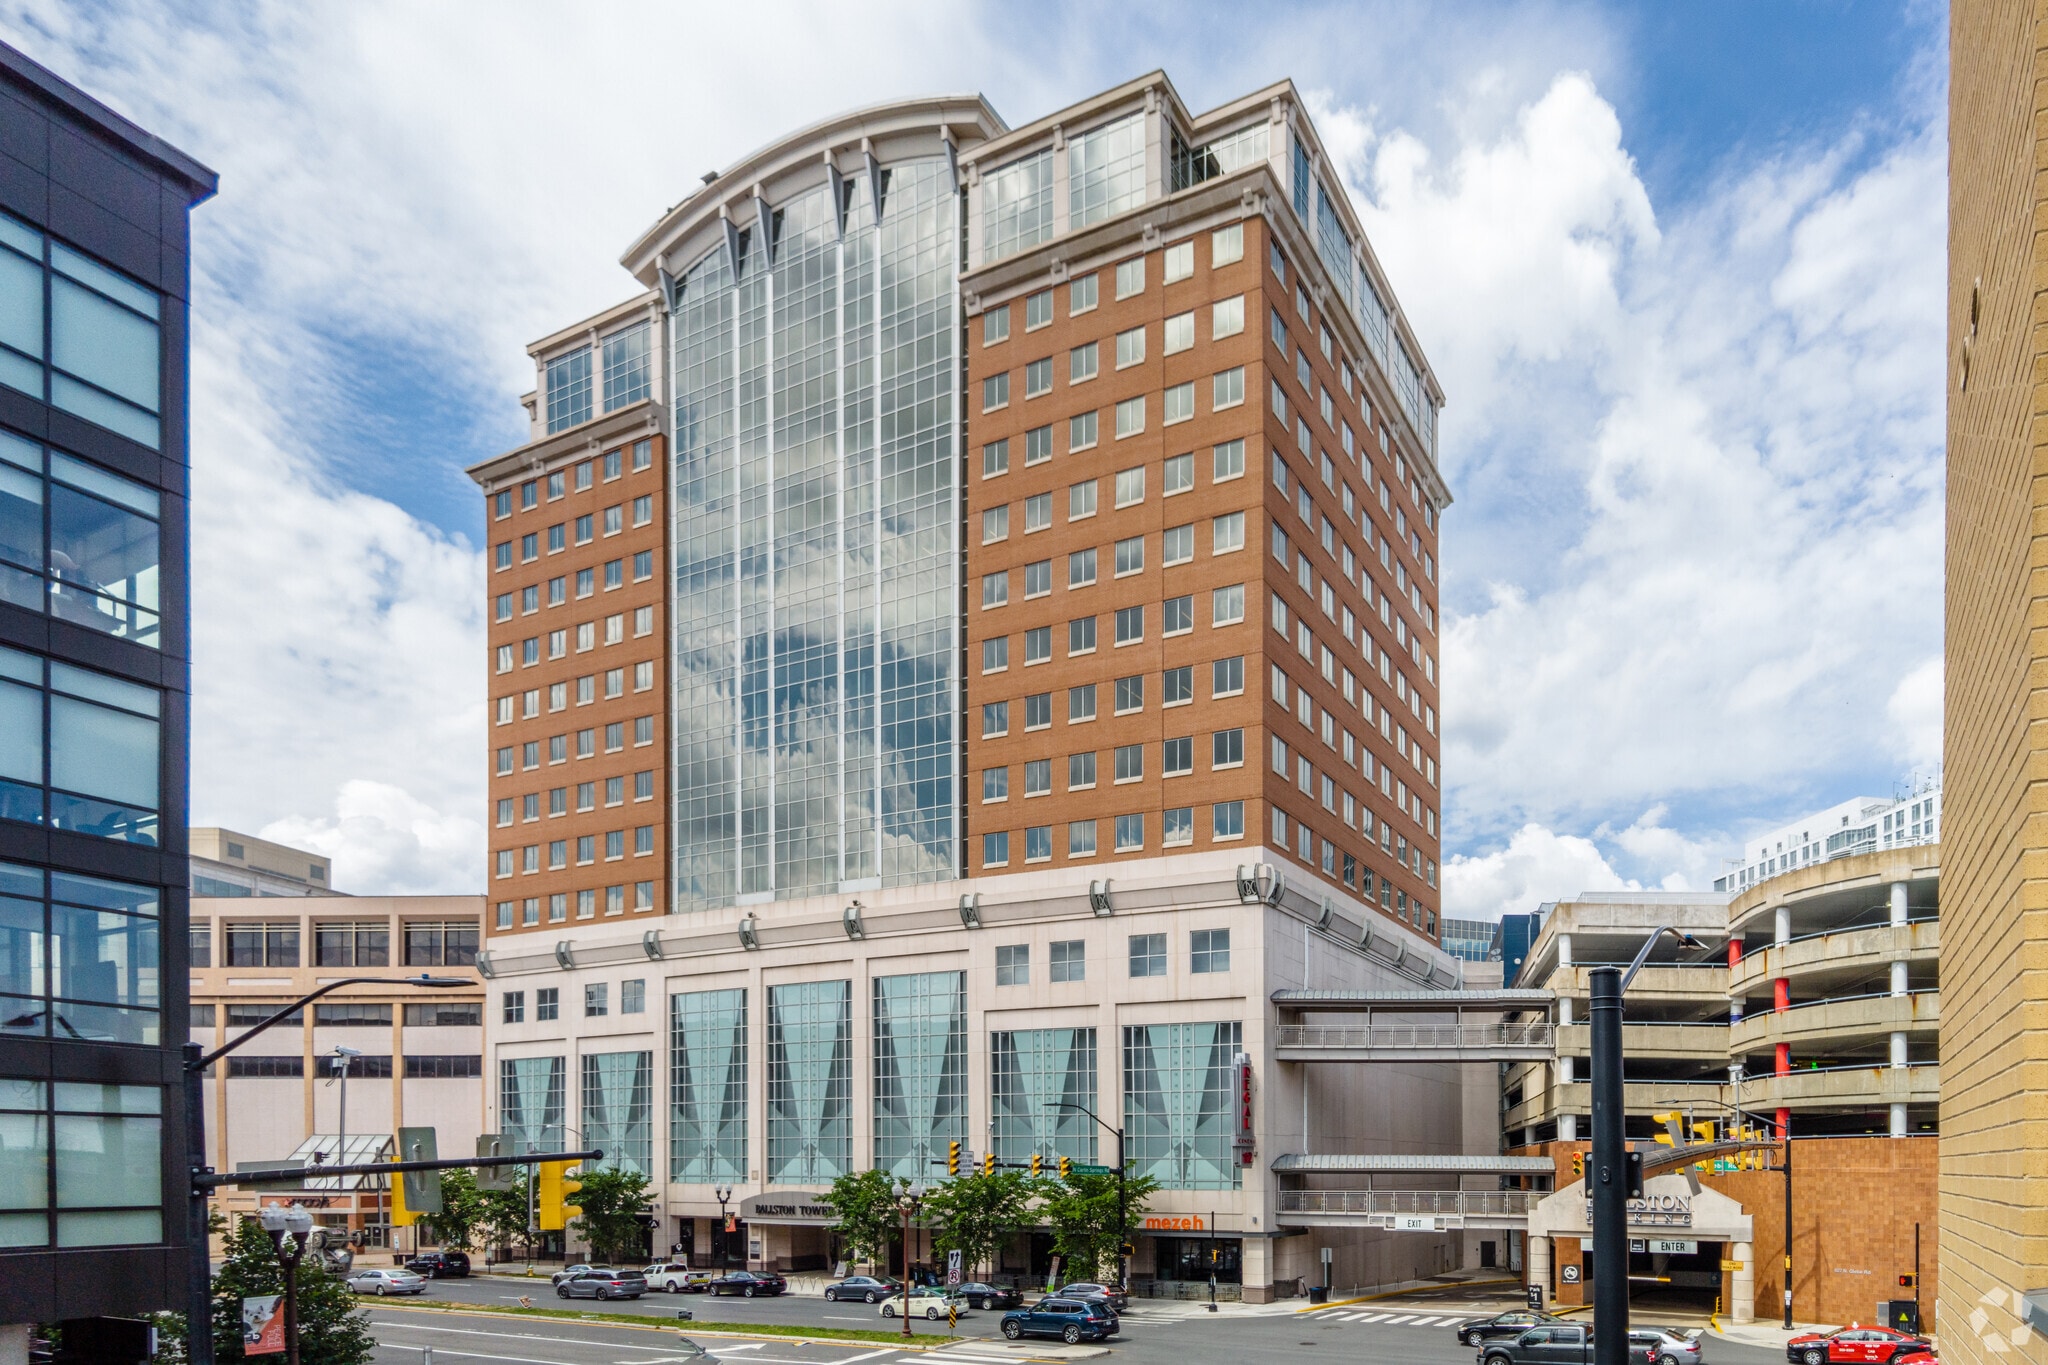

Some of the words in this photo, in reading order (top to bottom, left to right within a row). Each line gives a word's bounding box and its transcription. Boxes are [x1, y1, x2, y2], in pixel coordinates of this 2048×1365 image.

[1242, 1066, 1251, 1130] REGAL
[755, 1204, 795, 1215] BALLSTON
[1146, 1215, 1204, 1231] mezeh
[1407, 1219, 1422, 1228] EXIT
[1661, 1242, 1685, 1252] ENTER
